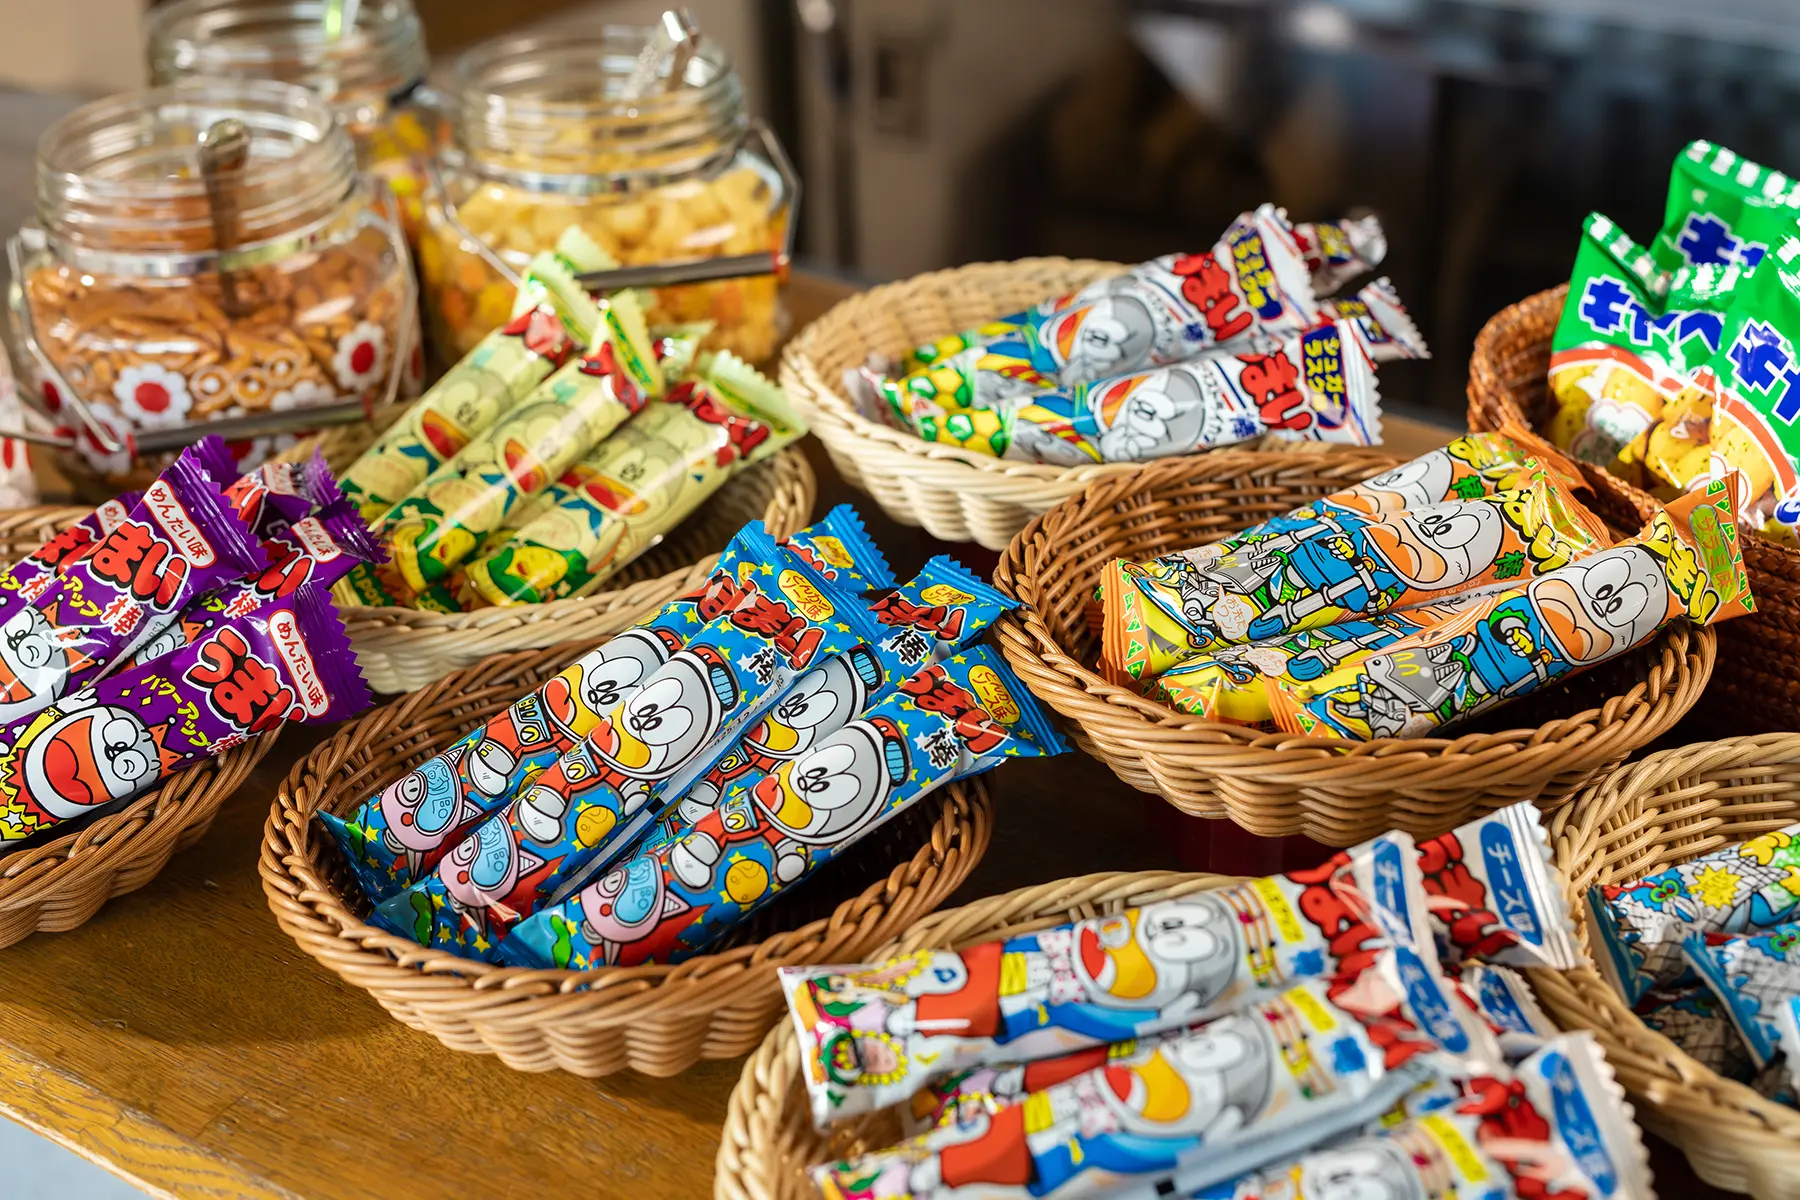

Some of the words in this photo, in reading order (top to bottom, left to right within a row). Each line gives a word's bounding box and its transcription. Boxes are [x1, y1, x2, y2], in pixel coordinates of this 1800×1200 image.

[150, 487, 208, 559] めんたい味
[1697, 516, 1733, 588] サラミ味
[80, 521, 192, 609] まい
[793, 575, 831, 611] とんかつ
[101, 597, 142, 635] 棒
[782, 577, 822, 620] ソース味
[277, 621, 324, 709] めんたい味
[890, 630, 929, 664] 棒
[186, 627, 305, 735] うまい
[901, 666, 1010, 754] うまい
[972, 673, 1007, 720] ソース味
[985, 672, 1017, 716] とんかつ
[140, 674, 212, 748] パワーアップ
[924, 729, 959, 768] 棒
